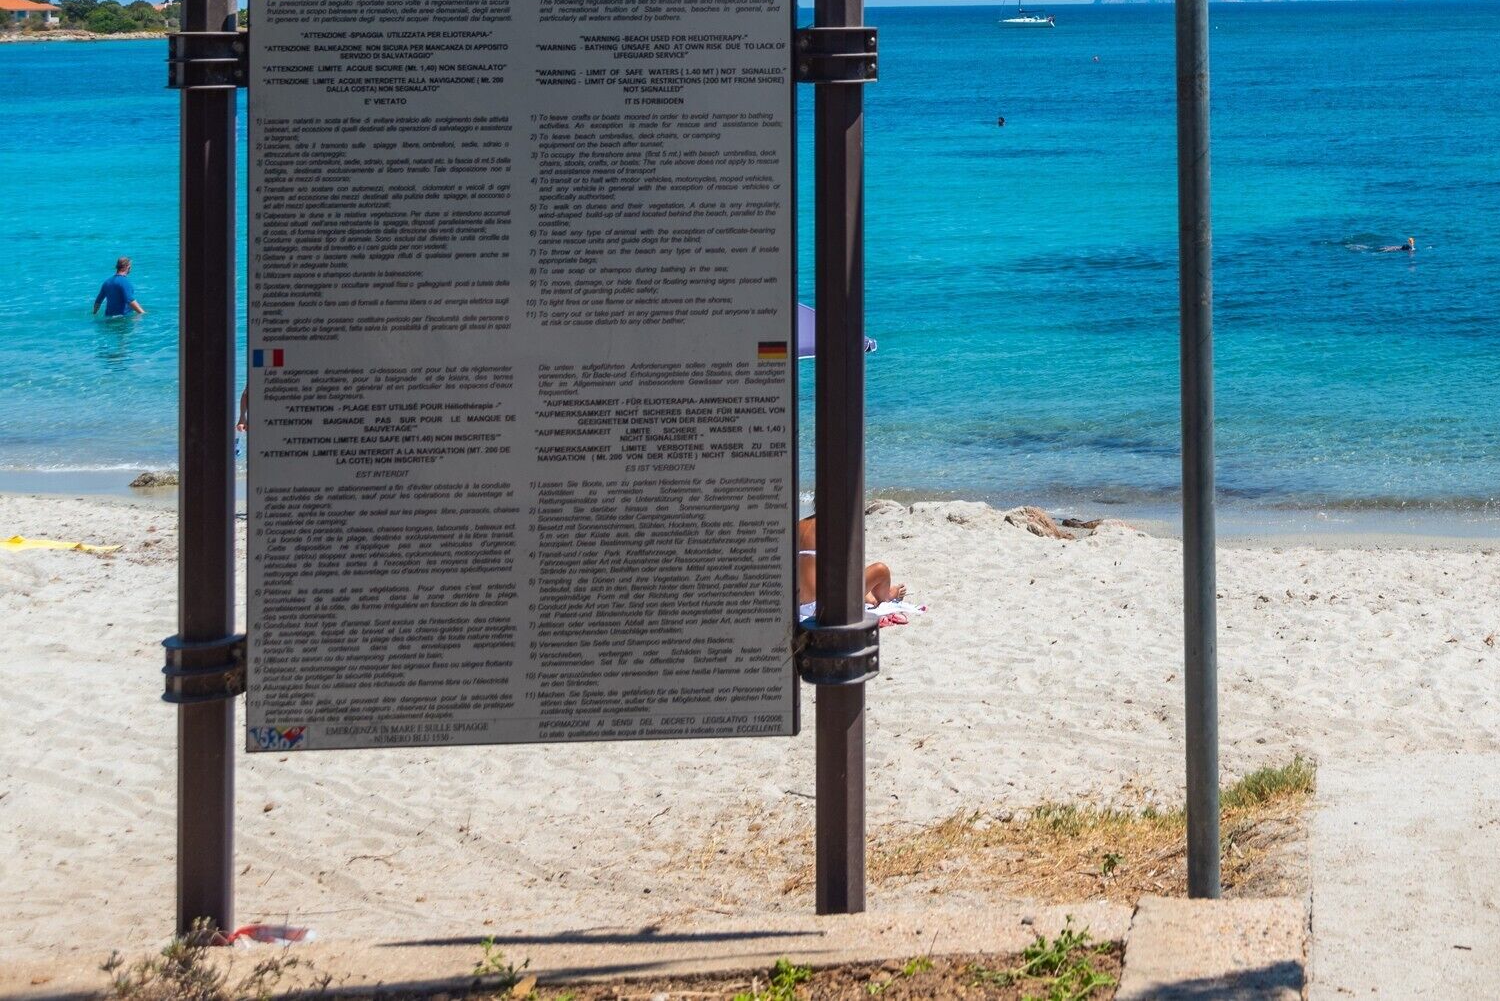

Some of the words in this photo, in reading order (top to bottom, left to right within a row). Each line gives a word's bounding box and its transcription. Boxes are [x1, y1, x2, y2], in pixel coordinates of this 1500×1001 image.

[703, 77, 719, 85] (200
[543, 399, 619, 407] "AUFMERKSAMKEIT
[744, 396, 780, 404] STRAND"
[342, 404, 370, 412] PLAGE
[420, 403, 443, 411] POUR
[323, 417, 365, 425] BAIGNADE
[283, 436, 331, 444] "ATTENTION
[379, 435, 400, 443] SAFE
[374, 470, 409, 478] INTERDIT
[326, 726, 378, 735] EMERGENZA
[391, 725, 416, 733] MARE
[424, 724, 451, 732] SULLE
[453, 722, 489, 732] SPIAGGE
[374, 735, 411, 743] NUMERO
